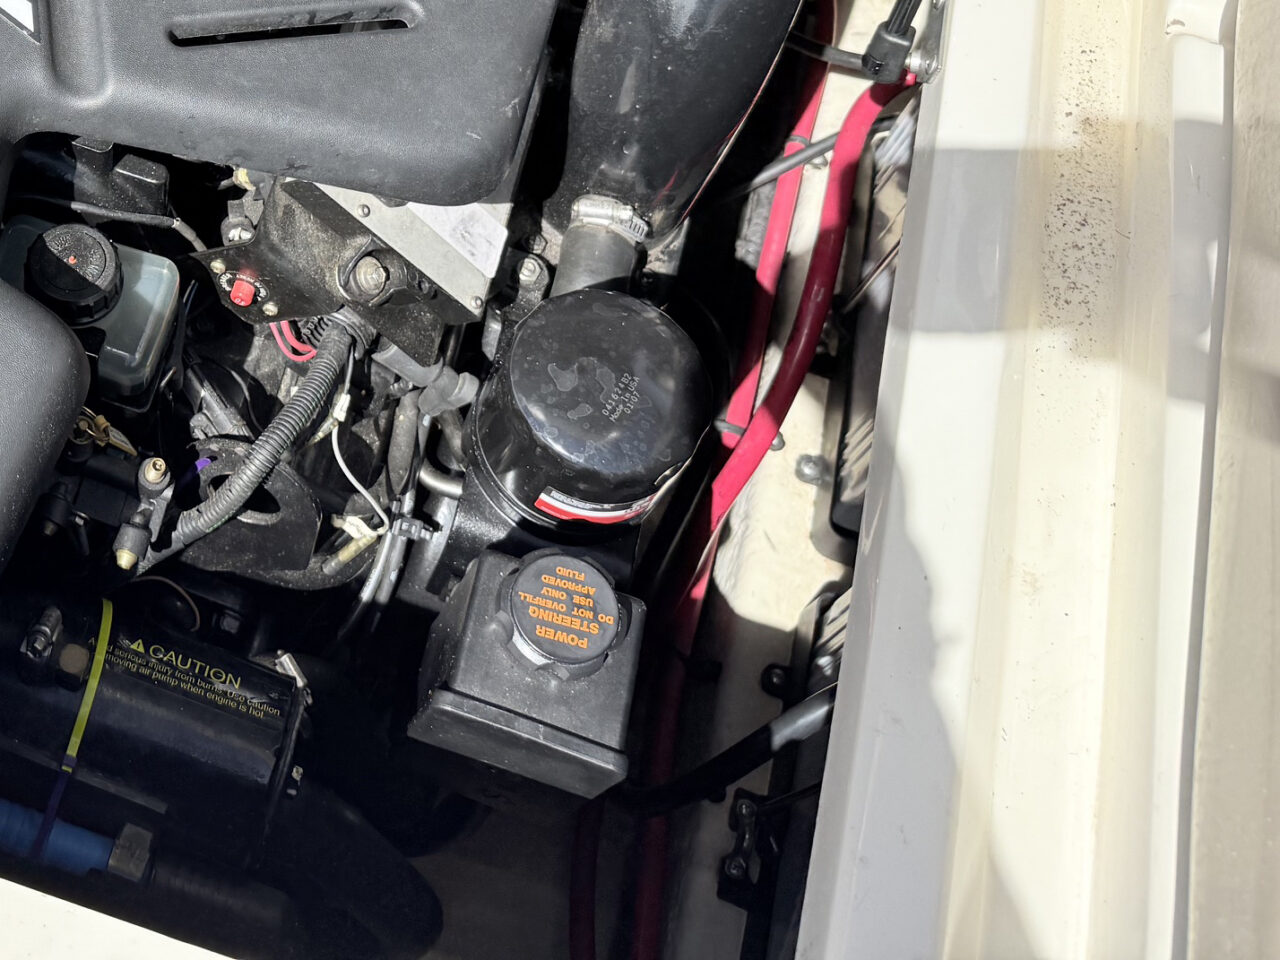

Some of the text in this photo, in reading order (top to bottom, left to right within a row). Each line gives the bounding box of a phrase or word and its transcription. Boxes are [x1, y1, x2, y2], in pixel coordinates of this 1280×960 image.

[627, 376, 640, 391] USA
[541, 574, 597, 596] APPROVED
[556, 566, 585, 581] FLUID
[518, 591, 615, 625] DO NOT OVERFILL
[540, 588, 594, 607] USE ONLY
[528, 606, 600, 635] STEERING
[535, 625, 589, 649] POWER
[149, 644, 242, 690] CAUTION
[114, 648, 147, 665] serious
[148, 658, 174, 677] injury
[174, 670, 195, 684] from
[226, 689, 246, 703] Use
[247, 696, 281, 716] caution
[138, 666, 150, 678] air
[151, 671, 179, 687] pump
[180, 680, 204, 698] when
[206, 692, 237, 711] engine
[239, 702, 247, 711] is
[248, 705, 265, 719] hot
